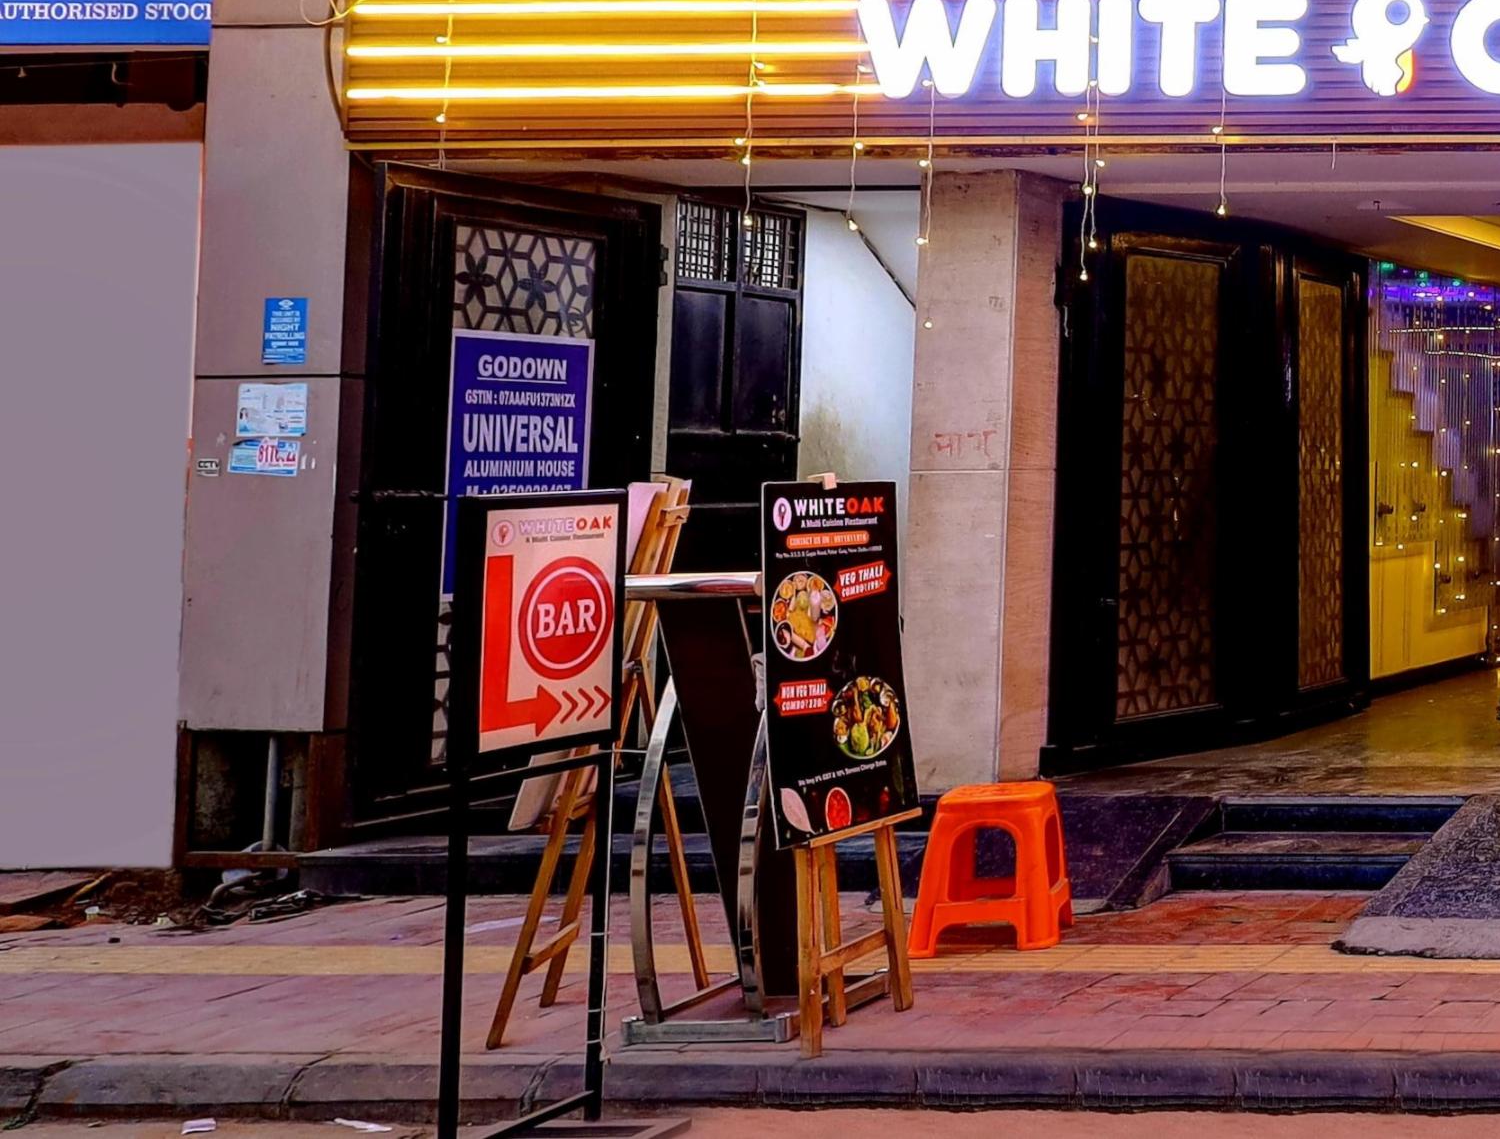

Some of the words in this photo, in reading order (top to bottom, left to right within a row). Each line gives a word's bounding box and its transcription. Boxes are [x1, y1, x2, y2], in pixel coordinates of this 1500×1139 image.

[478, 354, 567, 380] GODOWN
[464, 389, 493, 405] GSTIN
[462, 413, 578, 453] UNIVERSAL
[463, 460, 534, 478] ALUMINIUM
[536, 460, 576, 478] HOUSE
[839, 571, 857, 587] VEG
[858, 564, 884, 582] THALI
[536, 598, 597, 639] BAR
